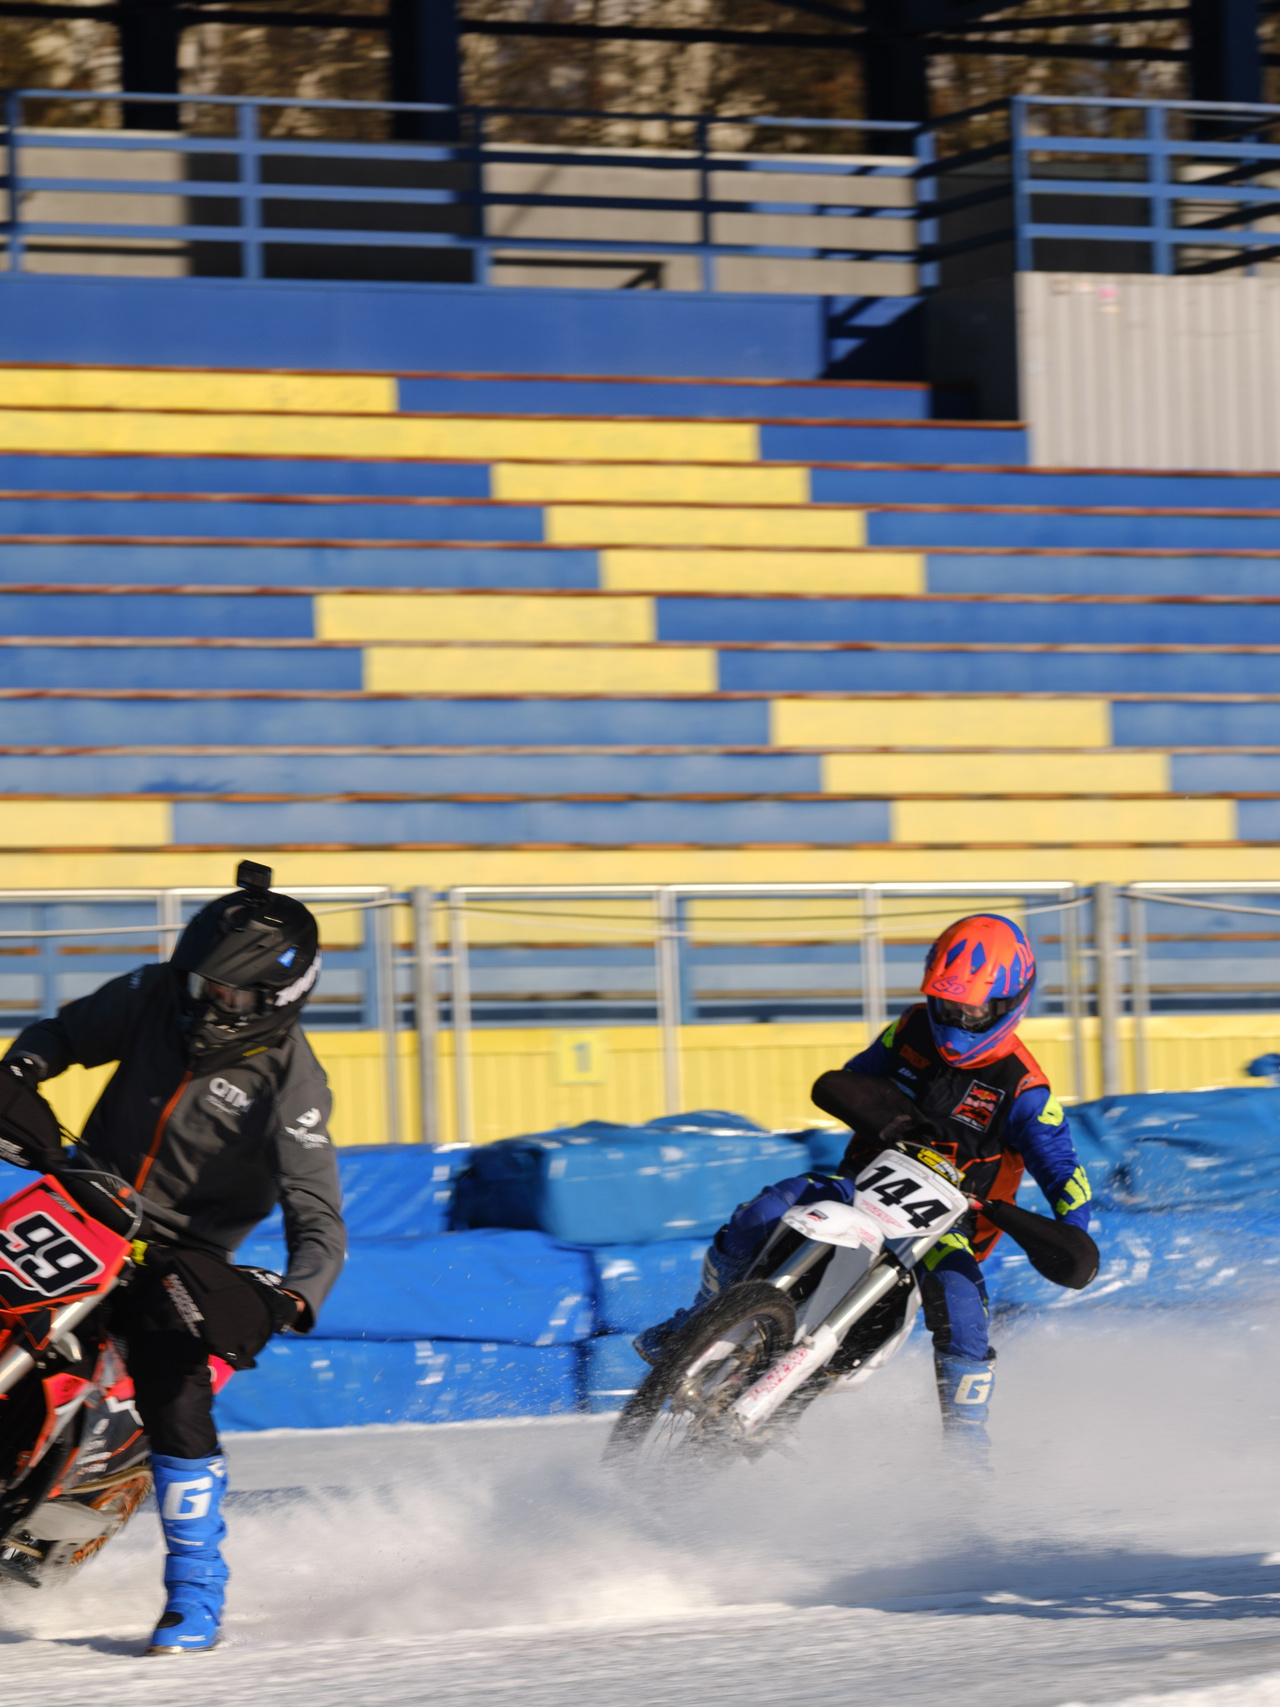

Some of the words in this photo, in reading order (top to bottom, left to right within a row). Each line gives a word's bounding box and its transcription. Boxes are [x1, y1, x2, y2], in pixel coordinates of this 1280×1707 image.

[855, 1165, 952, 1230] 144
[0, 1211, 106, 1297] 99
[953, 1371, 993, 1405] G
[162, 1477, 214, 1521] G
